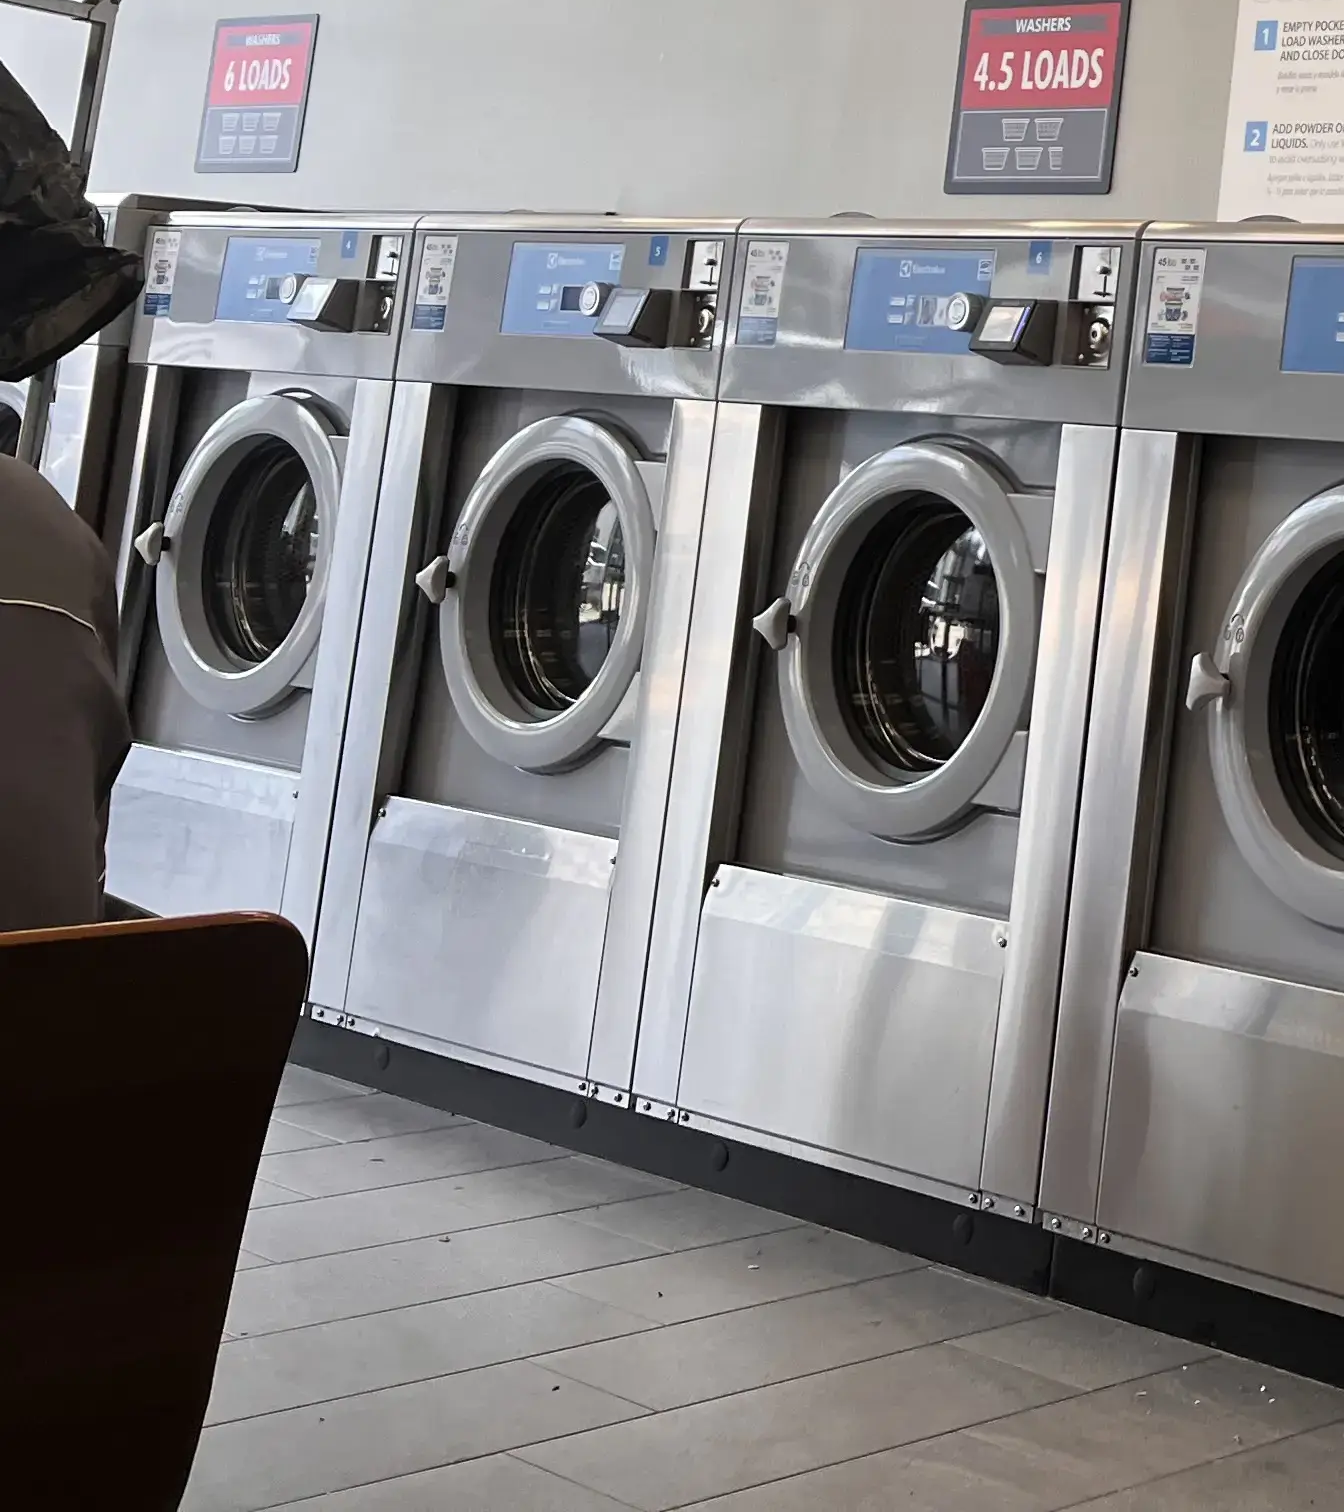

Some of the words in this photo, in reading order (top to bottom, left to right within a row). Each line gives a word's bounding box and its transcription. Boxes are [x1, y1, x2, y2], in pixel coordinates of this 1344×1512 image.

[1015, 17, 1071, 33] WASHERS
[1283, 21, 1313, 33] EMPTY
[1281, 36, 1306, 47] LOAD
[1280, 50, 1300, 61] AND
[1301, 50, 1330, 61] CLOSE
[224, 60, 236, 92] 6
[238, 58, 292, 91] LOADS
[974, 51, 1014, 91] 4.5
[1021, 48, 1104, 90] LOADS
[1272, 123, 1292, 134] ADD
[1294, 123, 1333, 134] POWDER
[1250, 129, 1260, 147] 2
[1271, 138, 1308, 150] LIQUIDS.
[654, 246, 661, 257] 5
[1035, 252, 1043, 264] 6
